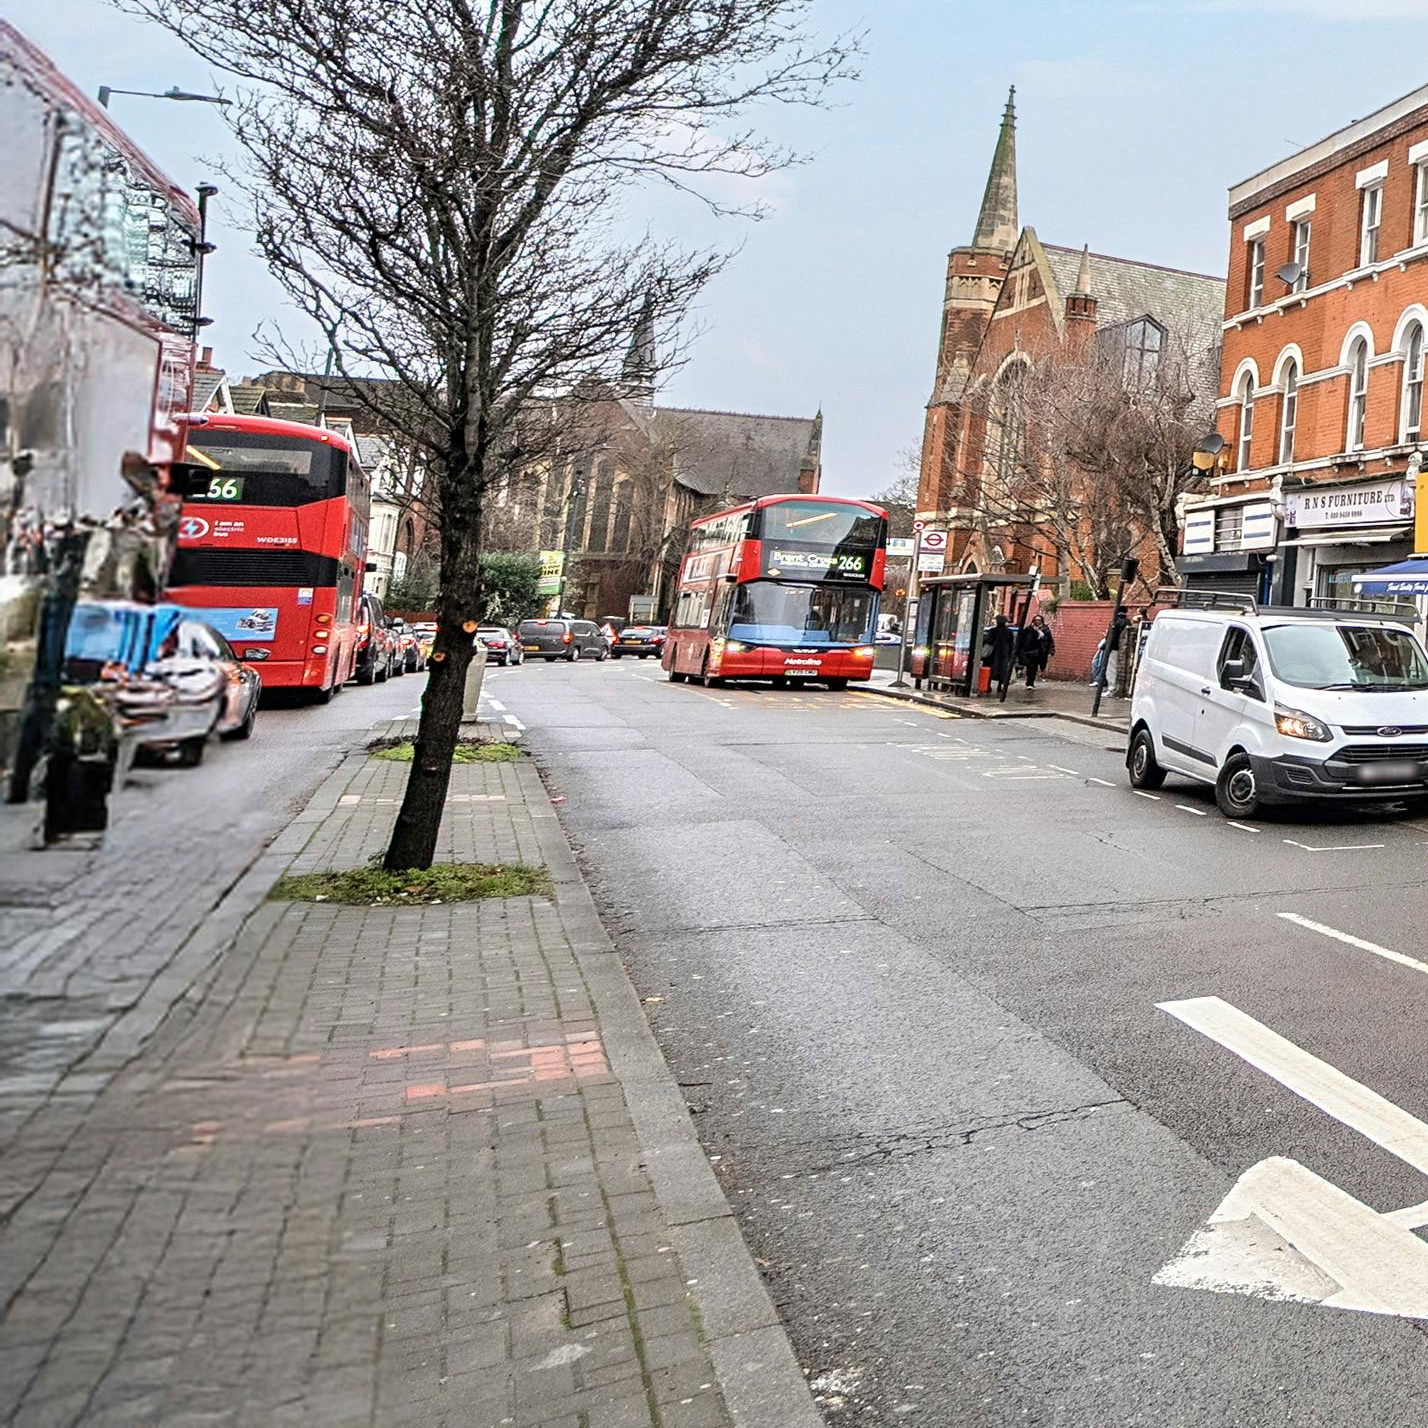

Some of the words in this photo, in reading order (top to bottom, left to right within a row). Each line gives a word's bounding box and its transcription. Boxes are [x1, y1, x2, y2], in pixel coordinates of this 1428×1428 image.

[1304, 498, 1310, 510] R
[1312, 497, 1320, 509] N
[1321, 496, 1326, 509] S
[1328, 490, 1383, 508] FURNITURE
[838, 555, 863, 571] 266
